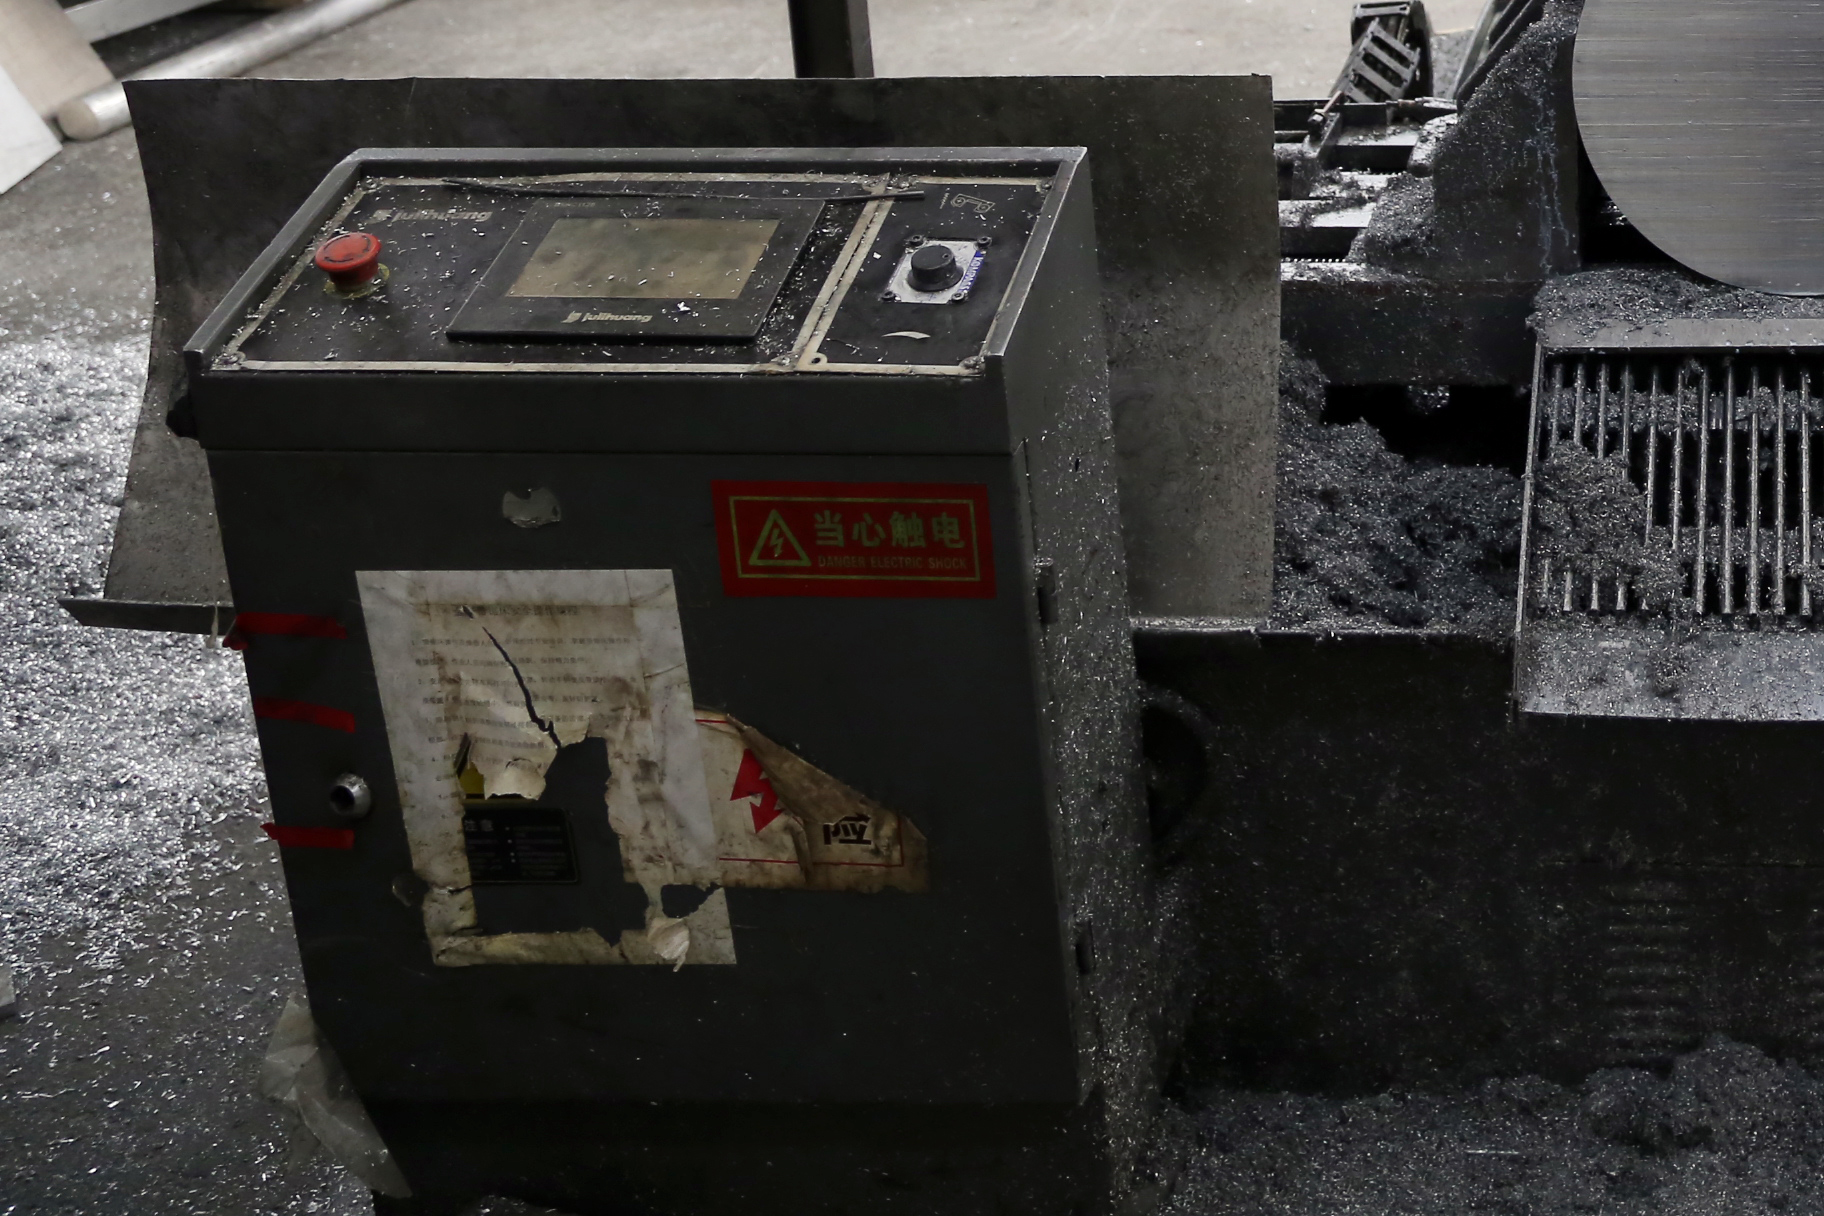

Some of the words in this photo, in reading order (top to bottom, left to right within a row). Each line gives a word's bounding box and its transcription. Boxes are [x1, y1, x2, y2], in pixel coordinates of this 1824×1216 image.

[581, 311, 653, 323] julihuang
[814, 510, 965, 549] 当心触电
[818, 555, 865, 568] DANGER
[870, 556, 923, 569] ELECTRIC
[928, 556, 967, 569] SHOCK
